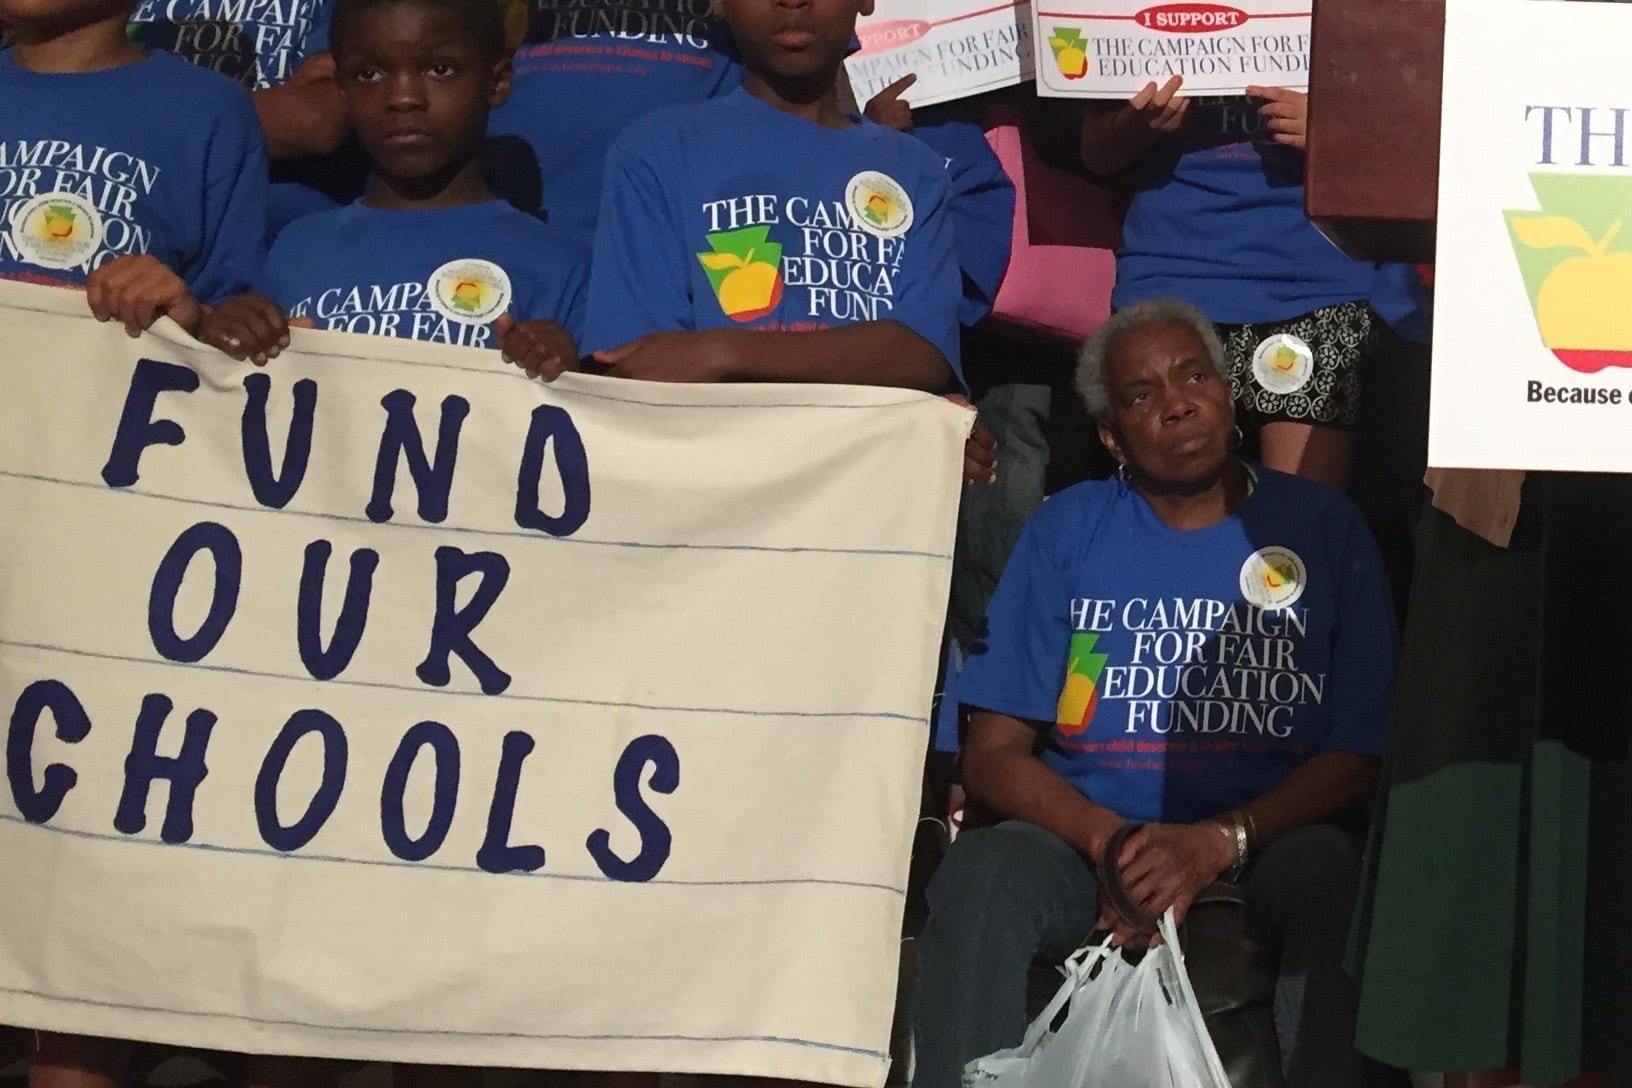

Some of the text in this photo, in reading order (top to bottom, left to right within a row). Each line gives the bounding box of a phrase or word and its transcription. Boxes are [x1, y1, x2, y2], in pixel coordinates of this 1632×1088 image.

[1144, 12, 1240, 26] I SUPPORT
[1092, 36, 1292, 56] THE CAMPAIGN FOR
[1099, 56, 1236, 76] EDUCATION
[703, 193, 779, 232] THE
[803, 227, 869, 258] FOR
[1526, 380, 1623, 405] Because
[100, 358, 592, 539] FUND
[147, 520, 512, 697] OUR
[1122, 597, 1310, 638] CAMPAIGN
[1131, 631, 1298, 672] FOR FAIR
[1101, 665, 1326, 705] EDUCATION
[1125, 700, 1294, 738] FUNDING
